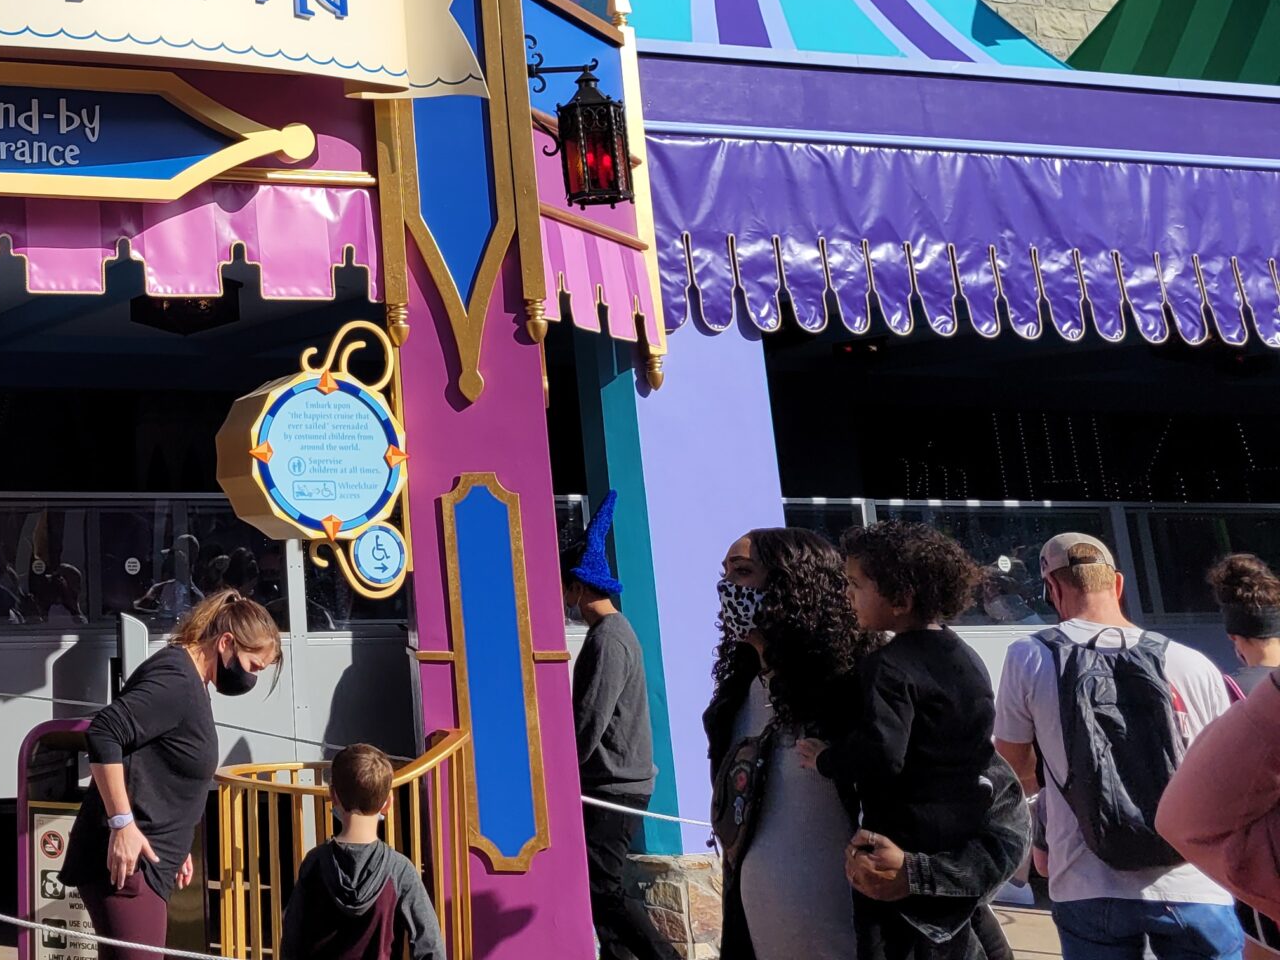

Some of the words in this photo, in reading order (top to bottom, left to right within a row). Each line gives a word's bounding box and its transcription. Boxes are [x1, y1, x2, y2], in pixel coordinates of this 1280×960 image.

[305, 401, 331, 409] Embark
[333, 403, 350, 411] upon
[303, 412, 332, 421] happiest
[355, 412, 369, 420] that
[283, 433, 292, 442] by
[328, 433, 355, 441] children
[300, 443, 325, 451] around
[326, 443, 337, 451] the
[308, 457, 342, 466] Supervise
[309, 466, 337, 474] children
[349, 466, 358, 474] all
[337, 481, 378, 489] Wheelchair
